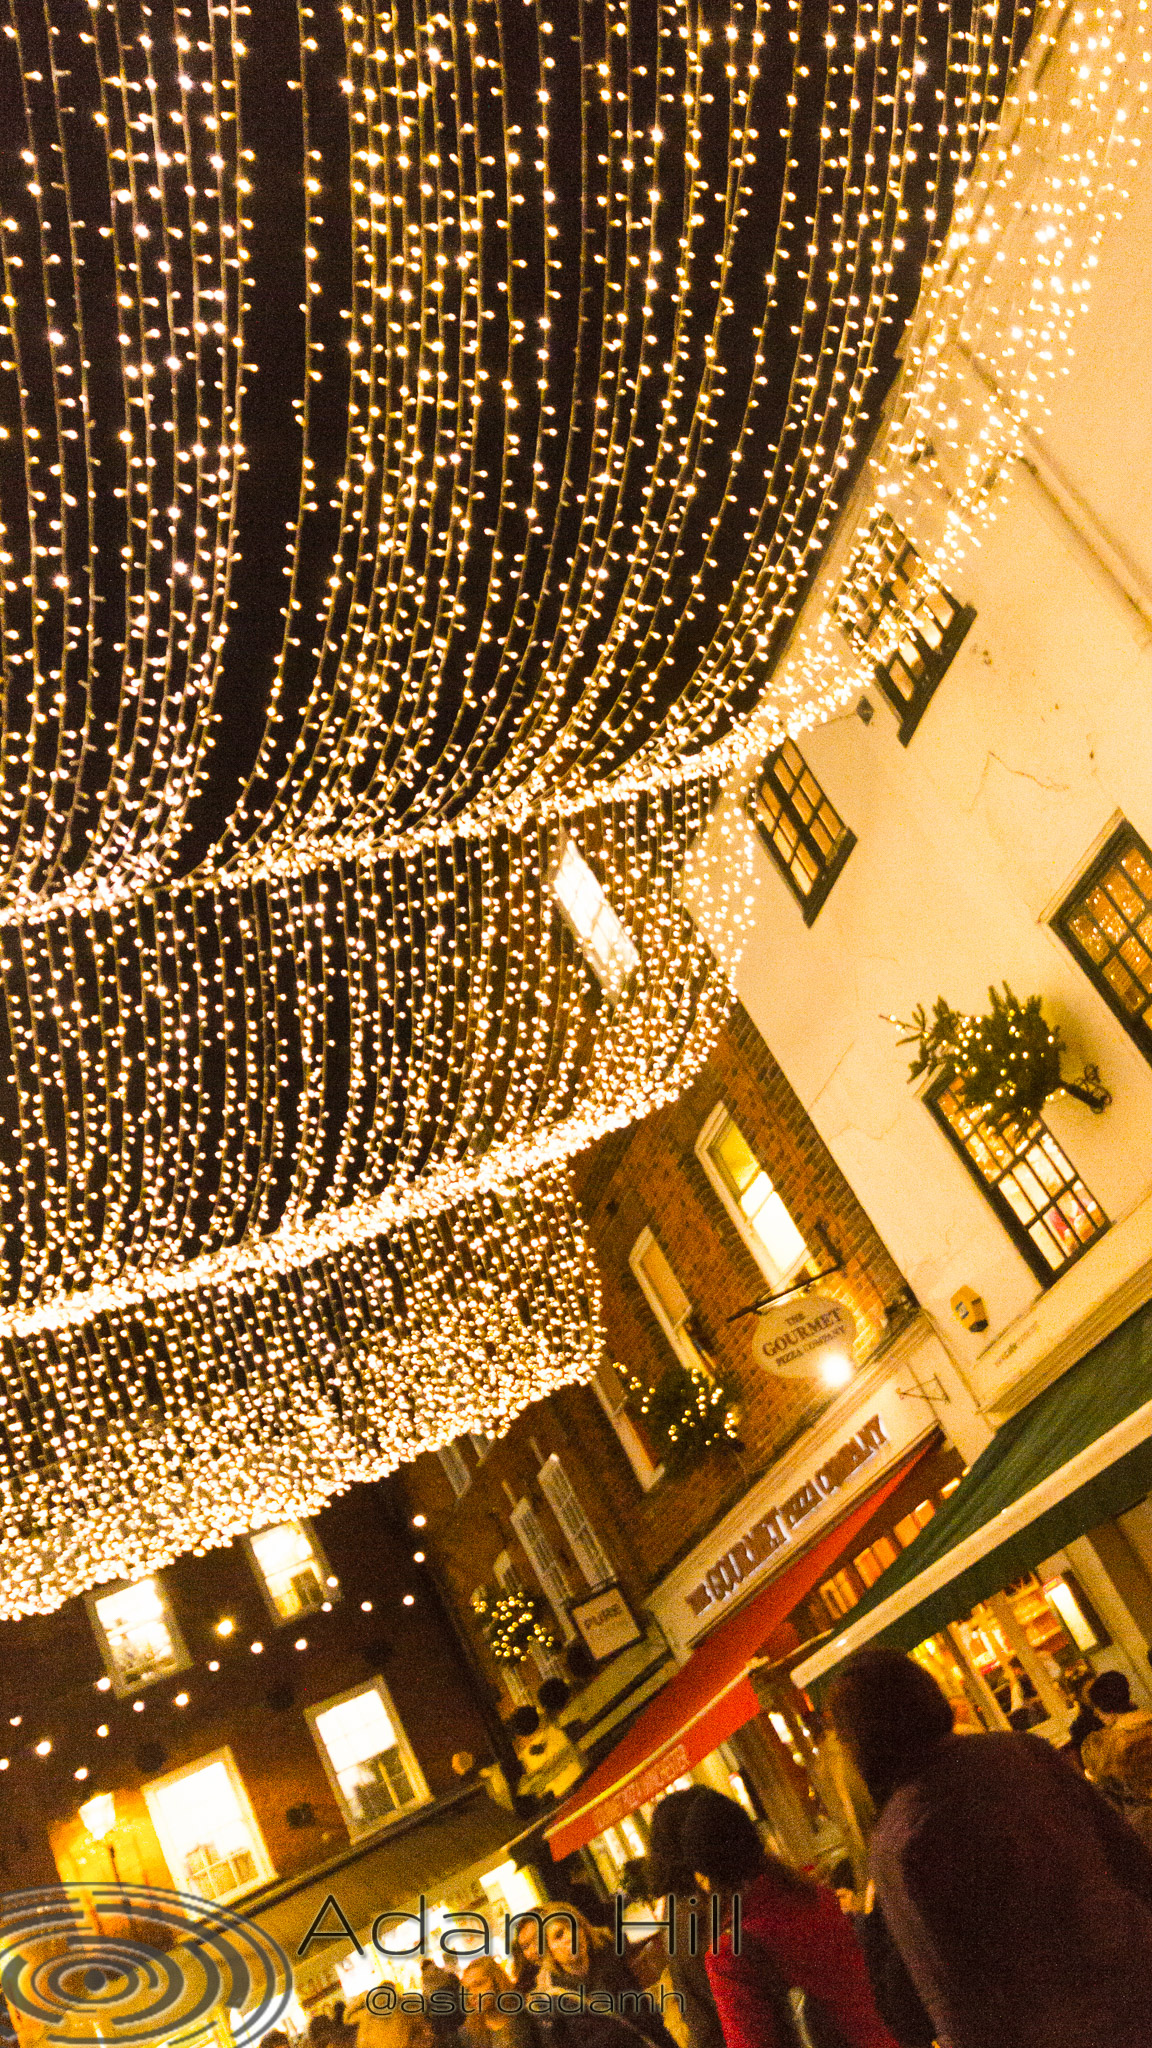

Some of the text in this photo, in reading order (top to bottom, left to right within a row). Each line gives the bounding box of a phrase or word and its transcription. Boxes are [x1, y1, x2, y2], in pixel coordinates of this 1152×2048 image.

[762, 1307, 841, 1357] GOURMET
[785, 1312, 806, 1326] THE
[776, 1349, 803, 1366] PIZZA
[706, 1506, 789, 1602] GOURMET
